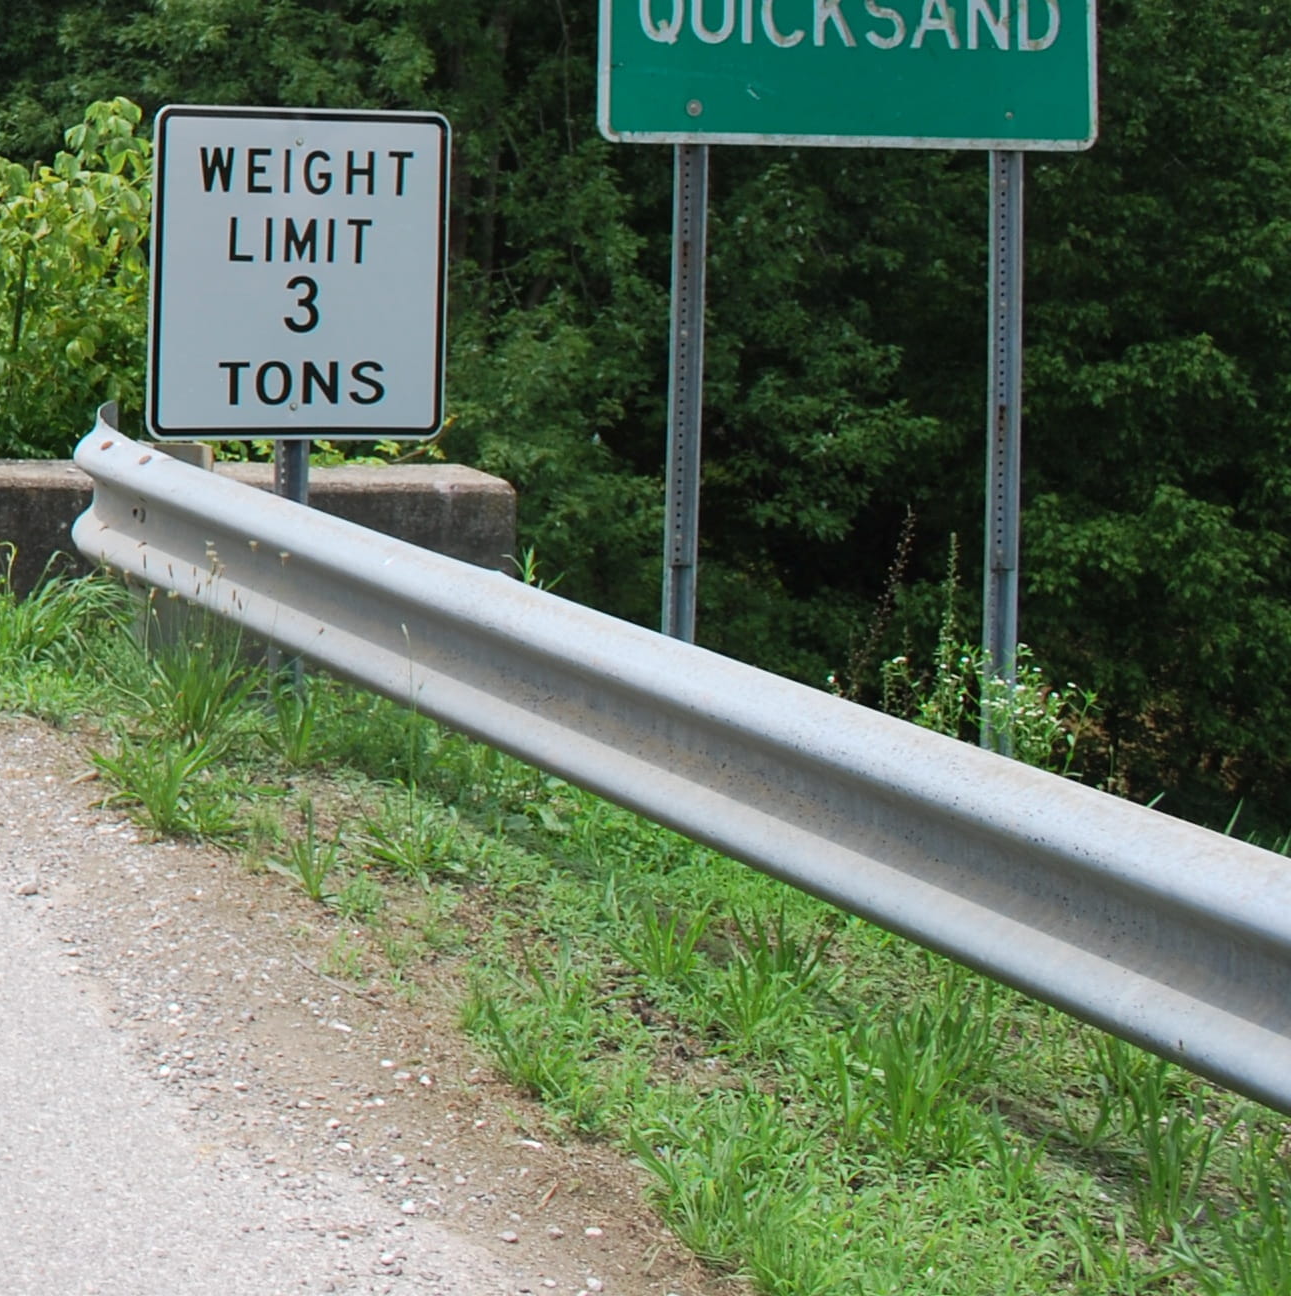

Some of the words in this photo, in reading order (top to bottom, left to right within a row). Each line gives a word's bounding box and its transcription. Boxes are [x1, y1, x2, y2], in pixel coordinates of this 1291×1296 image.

[200, 146, 414, 196] WEIGHT
[229, 216, 373, 264] LIMIT
[283, 275, 320, 333] 3
[219, 360, 386, 406] TONS
